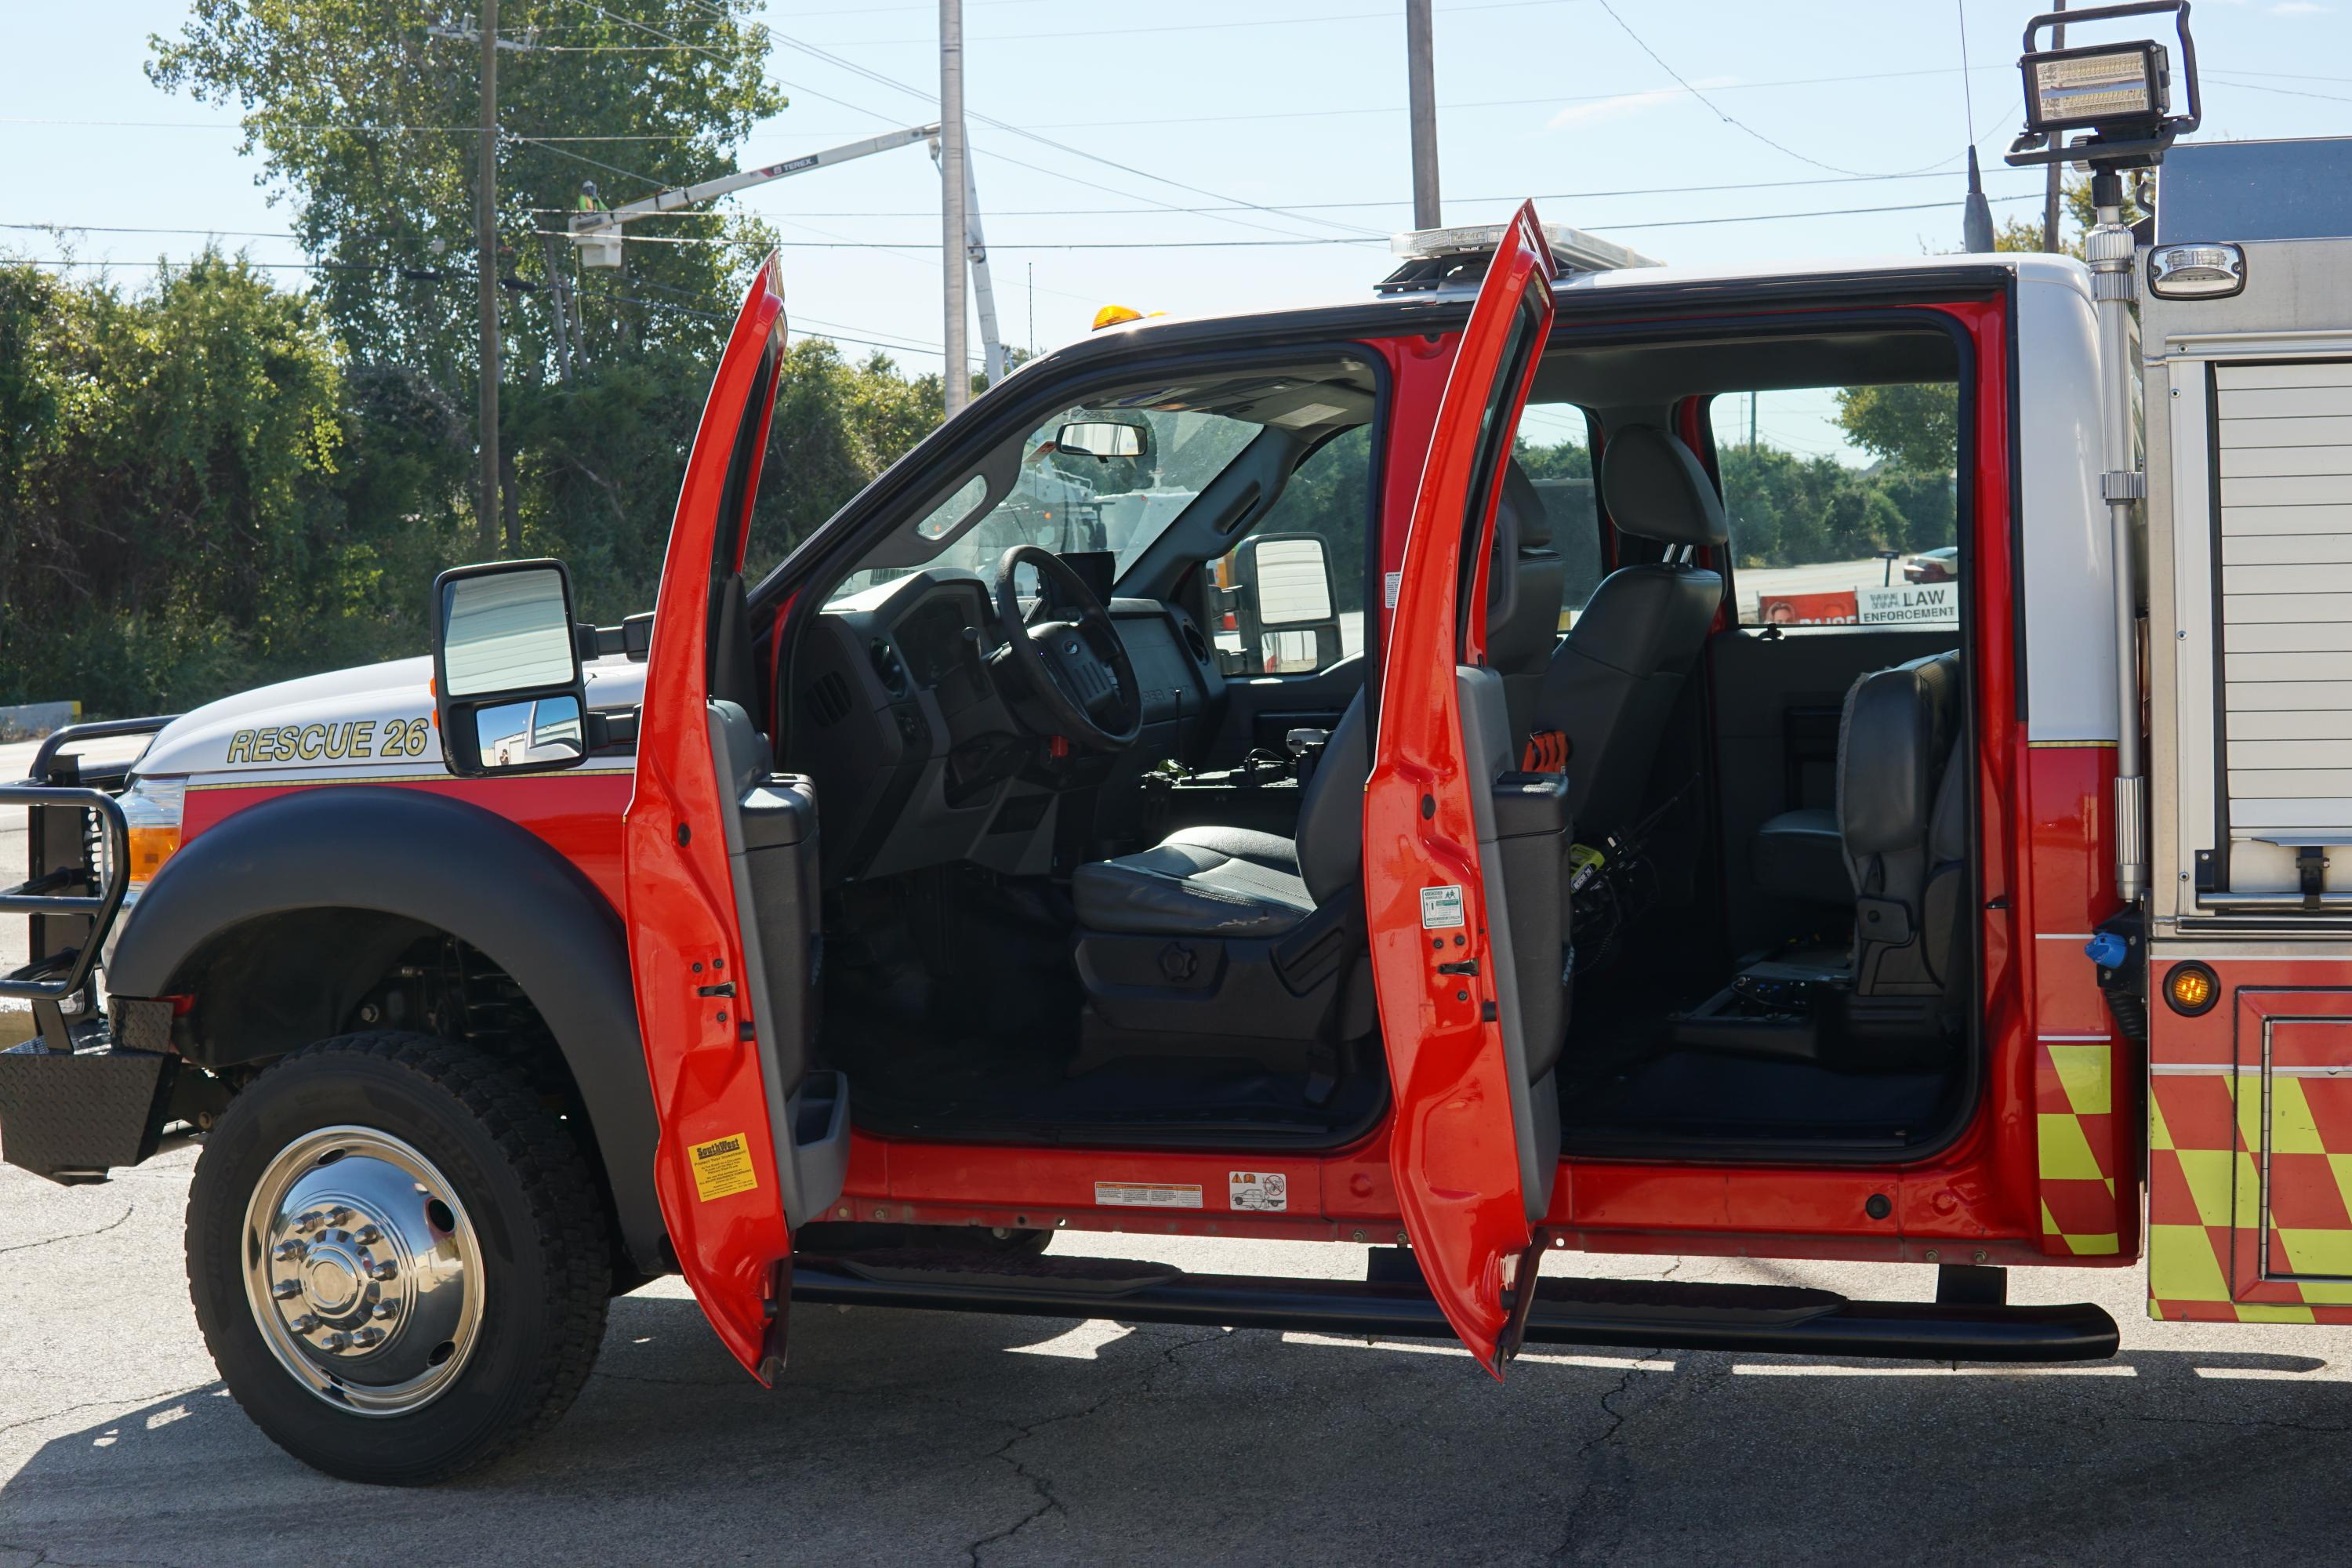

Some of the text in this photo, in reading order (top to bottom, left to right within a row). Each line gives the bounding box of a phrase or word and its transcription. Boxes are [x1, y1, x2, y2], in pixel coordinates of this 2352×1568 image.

[784, 158, 812, 171] TEREX
[1904, 590, 1945, 607] LAW
[1863, 606, 1955, 622] ENFORCEMENT
[227, 717, 430, 764] RESCUE 26
